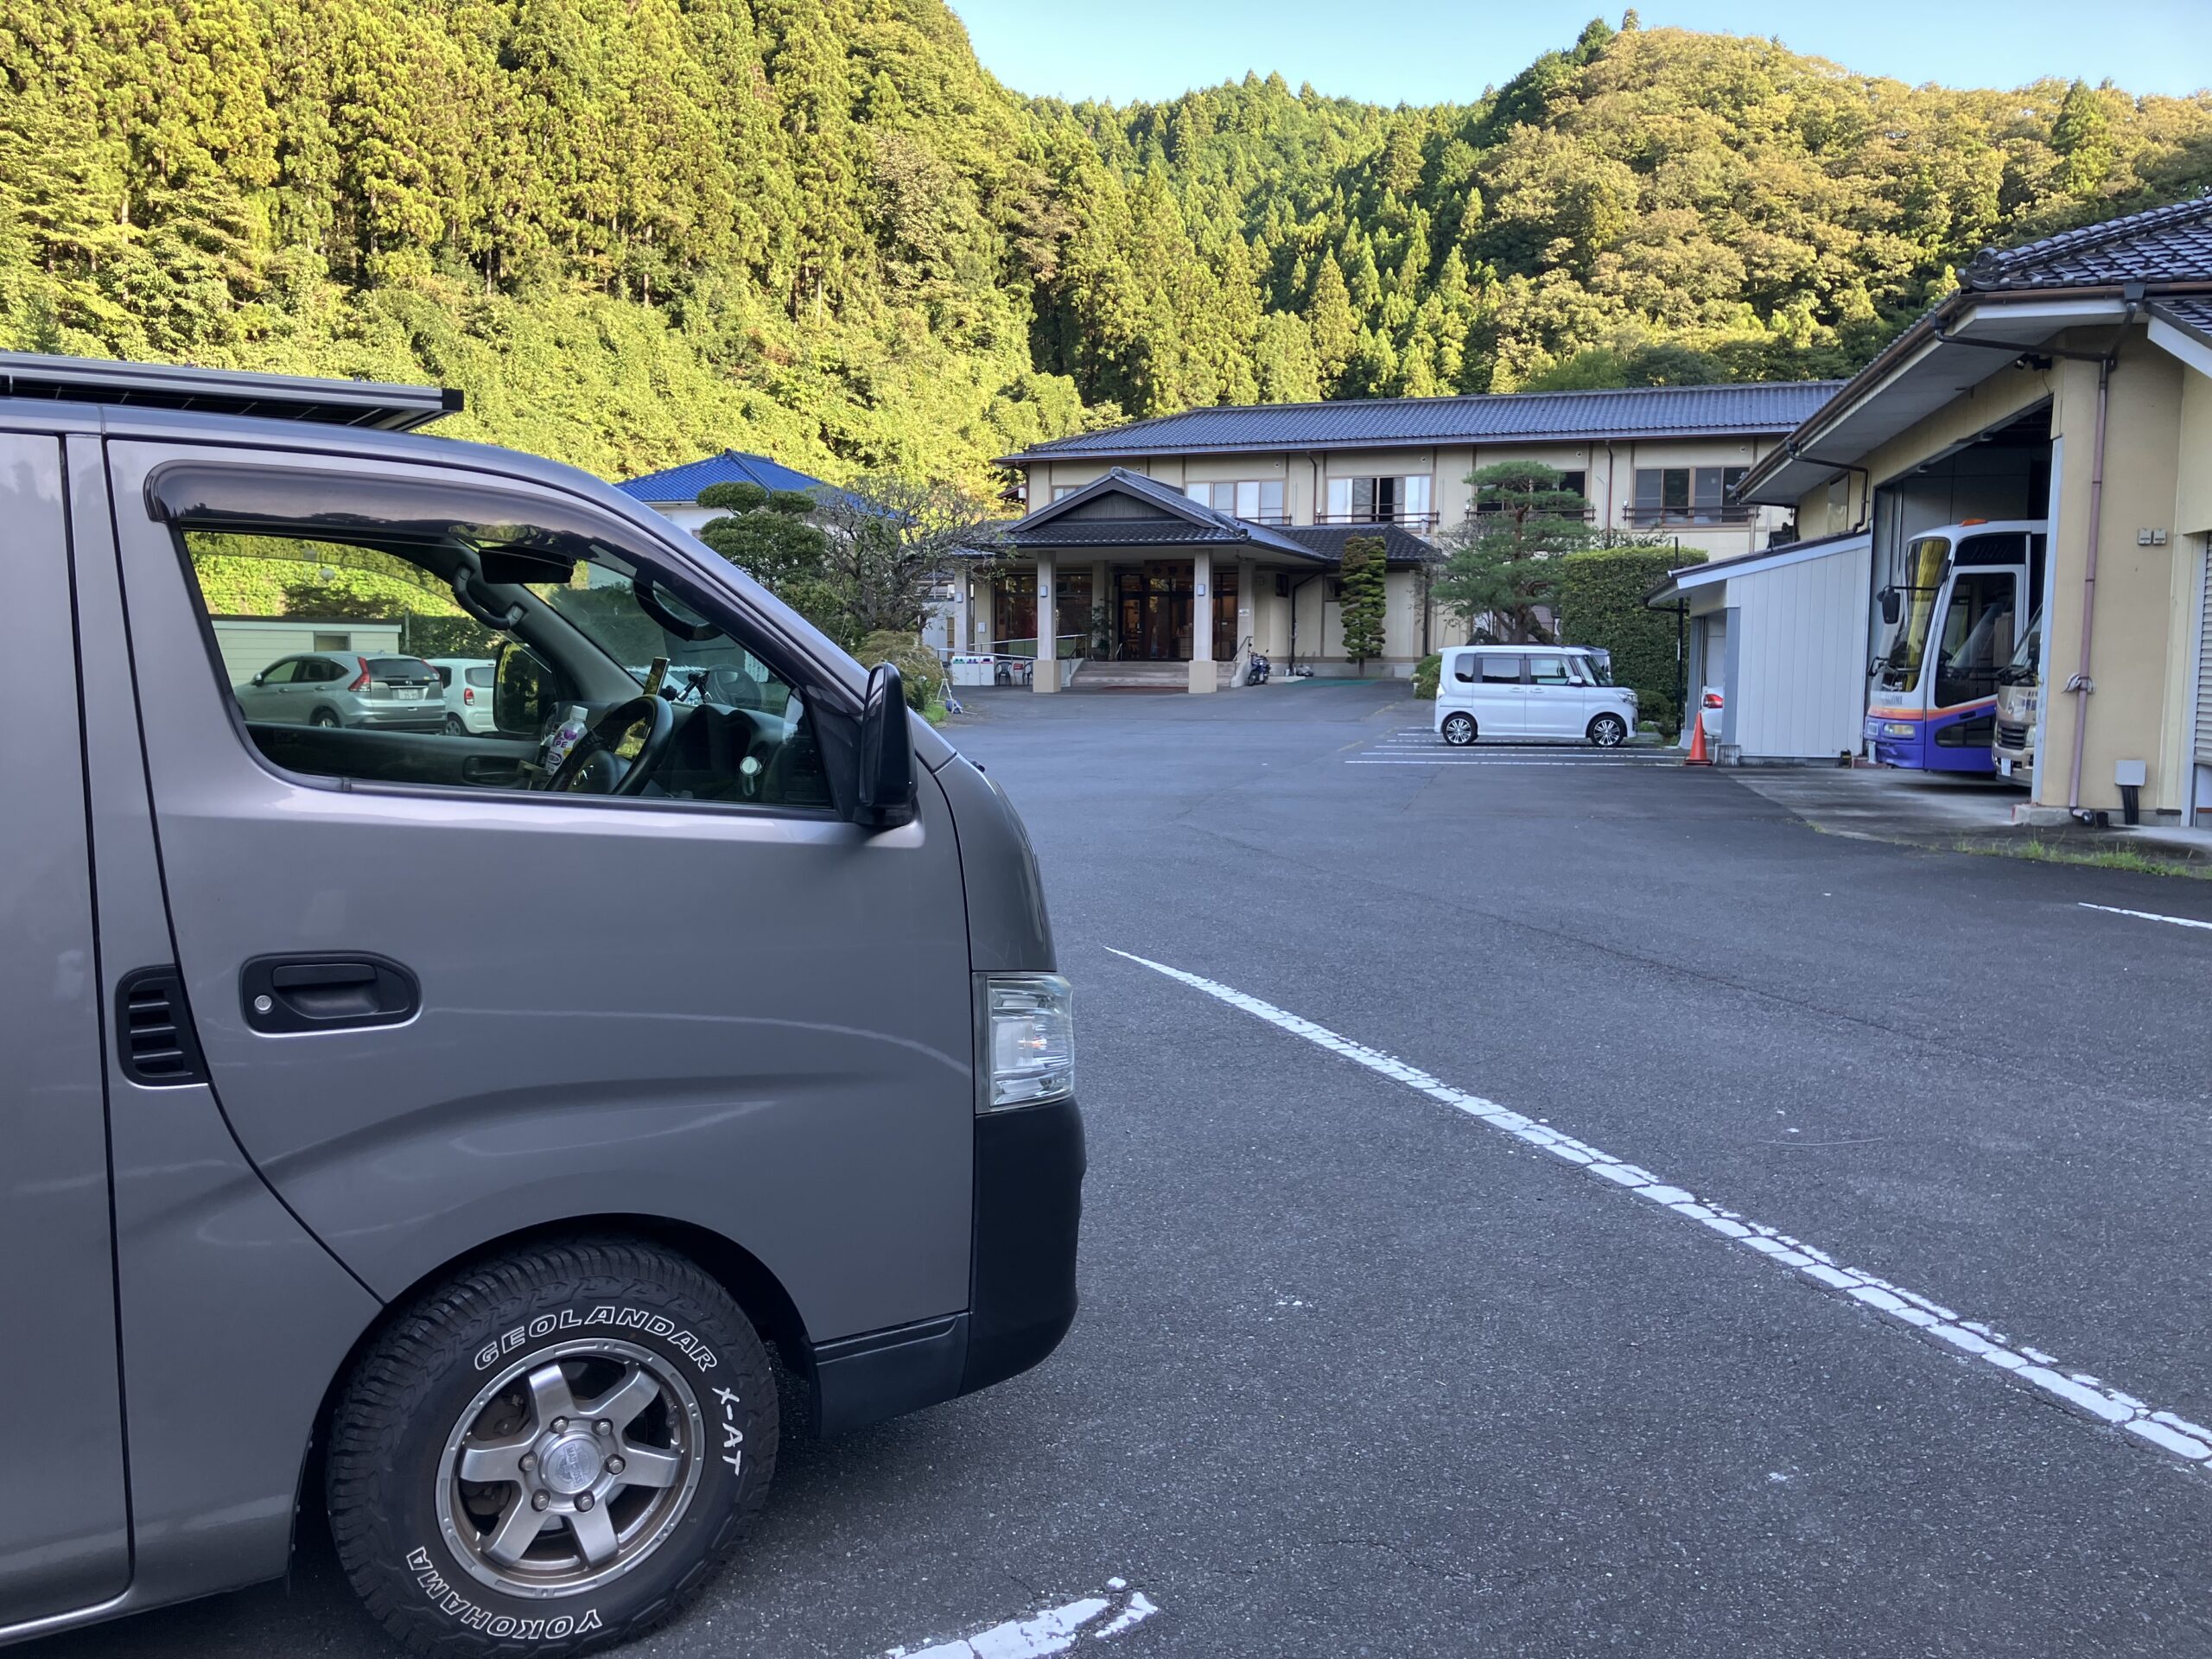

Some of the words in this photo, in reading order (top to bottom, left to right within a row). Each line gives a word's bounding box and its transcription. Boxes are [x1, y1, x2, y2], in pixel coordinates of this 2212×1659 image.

[474, 1306, 718, 1372] GEOLANDAR
[712, 1386, 742, 1476] X-AT
[565, 1446, 577, 1462] MAD
[406, 1547, 603, 1640] YOKOHAMA
